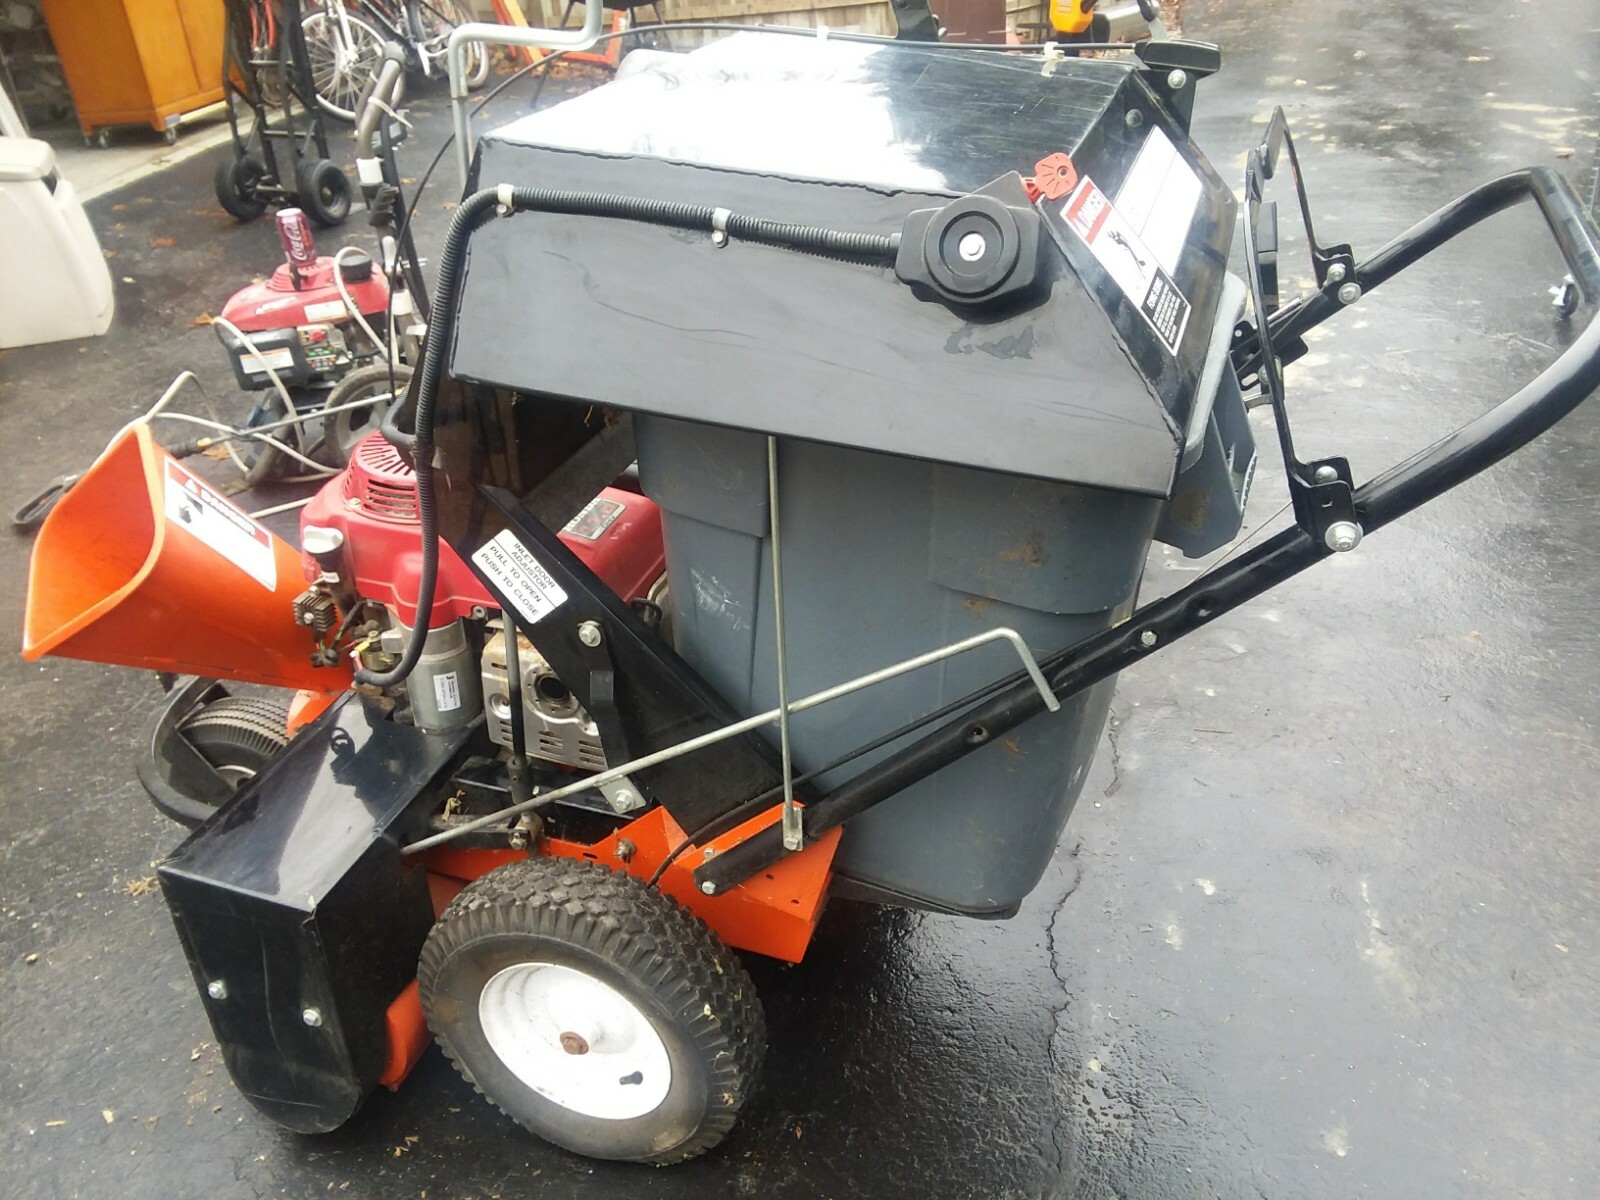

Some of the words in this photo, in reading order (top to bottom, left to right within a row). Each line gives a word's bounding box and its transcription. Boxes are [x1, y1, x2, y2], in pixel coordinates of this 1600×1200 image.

[1076, 188, 1106, 228] DANGER
[200, 488, 255, 536] DANGER
[561, 496, 602, 532] HONDA
[480, 553, 502, 575] PUSH
[502, 576, 513, 588] TO
[514, 589, 540, 616] CLOSE
[489, 546, 507, 567] PULL
[510, 567, 520, 579] TO
[521, 580, 542, 603] OPEN
[511, 551, 548, 590] ADJUSTOR
[514, 543, 535, 564] INLET
[534, 565, 556, 588] DOOR
